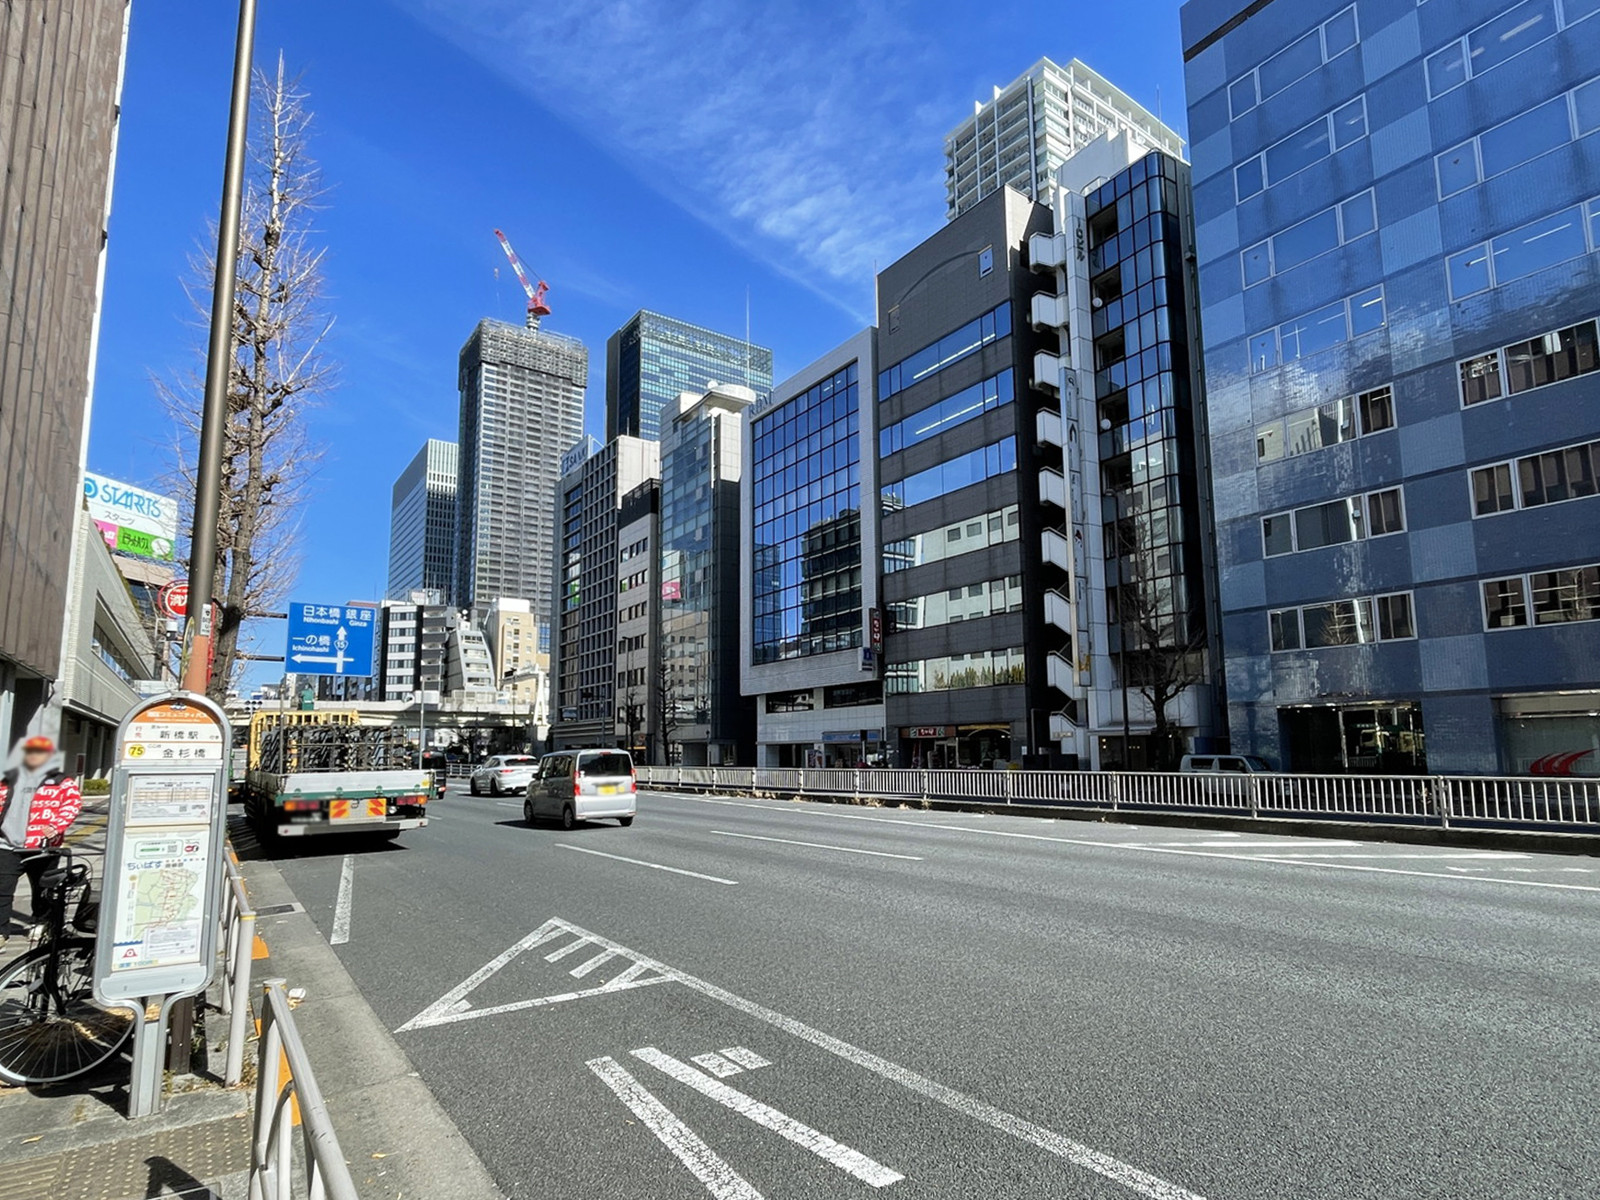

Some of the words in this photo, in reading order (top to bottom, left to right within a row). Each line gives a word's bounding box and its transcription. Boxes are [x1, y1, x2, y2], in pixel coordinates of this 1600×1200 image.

[100, 484, 161, 518] STARTS
[104, 510, 135, 525] スターツ
[303, 605, 340, 618] 日本橋
[345, 609, 372, 621] 銀座
[303, 617, 339, 625] Nihonbashi
[292, 634, 331, 646] 一の橋
[292, 645, 329, 653] Ichinohashi
[160, 730, 199, 740] 新橋駅
[130, 746, 144, 756] 75
[163, 748, 206, 758] 金杉橋
